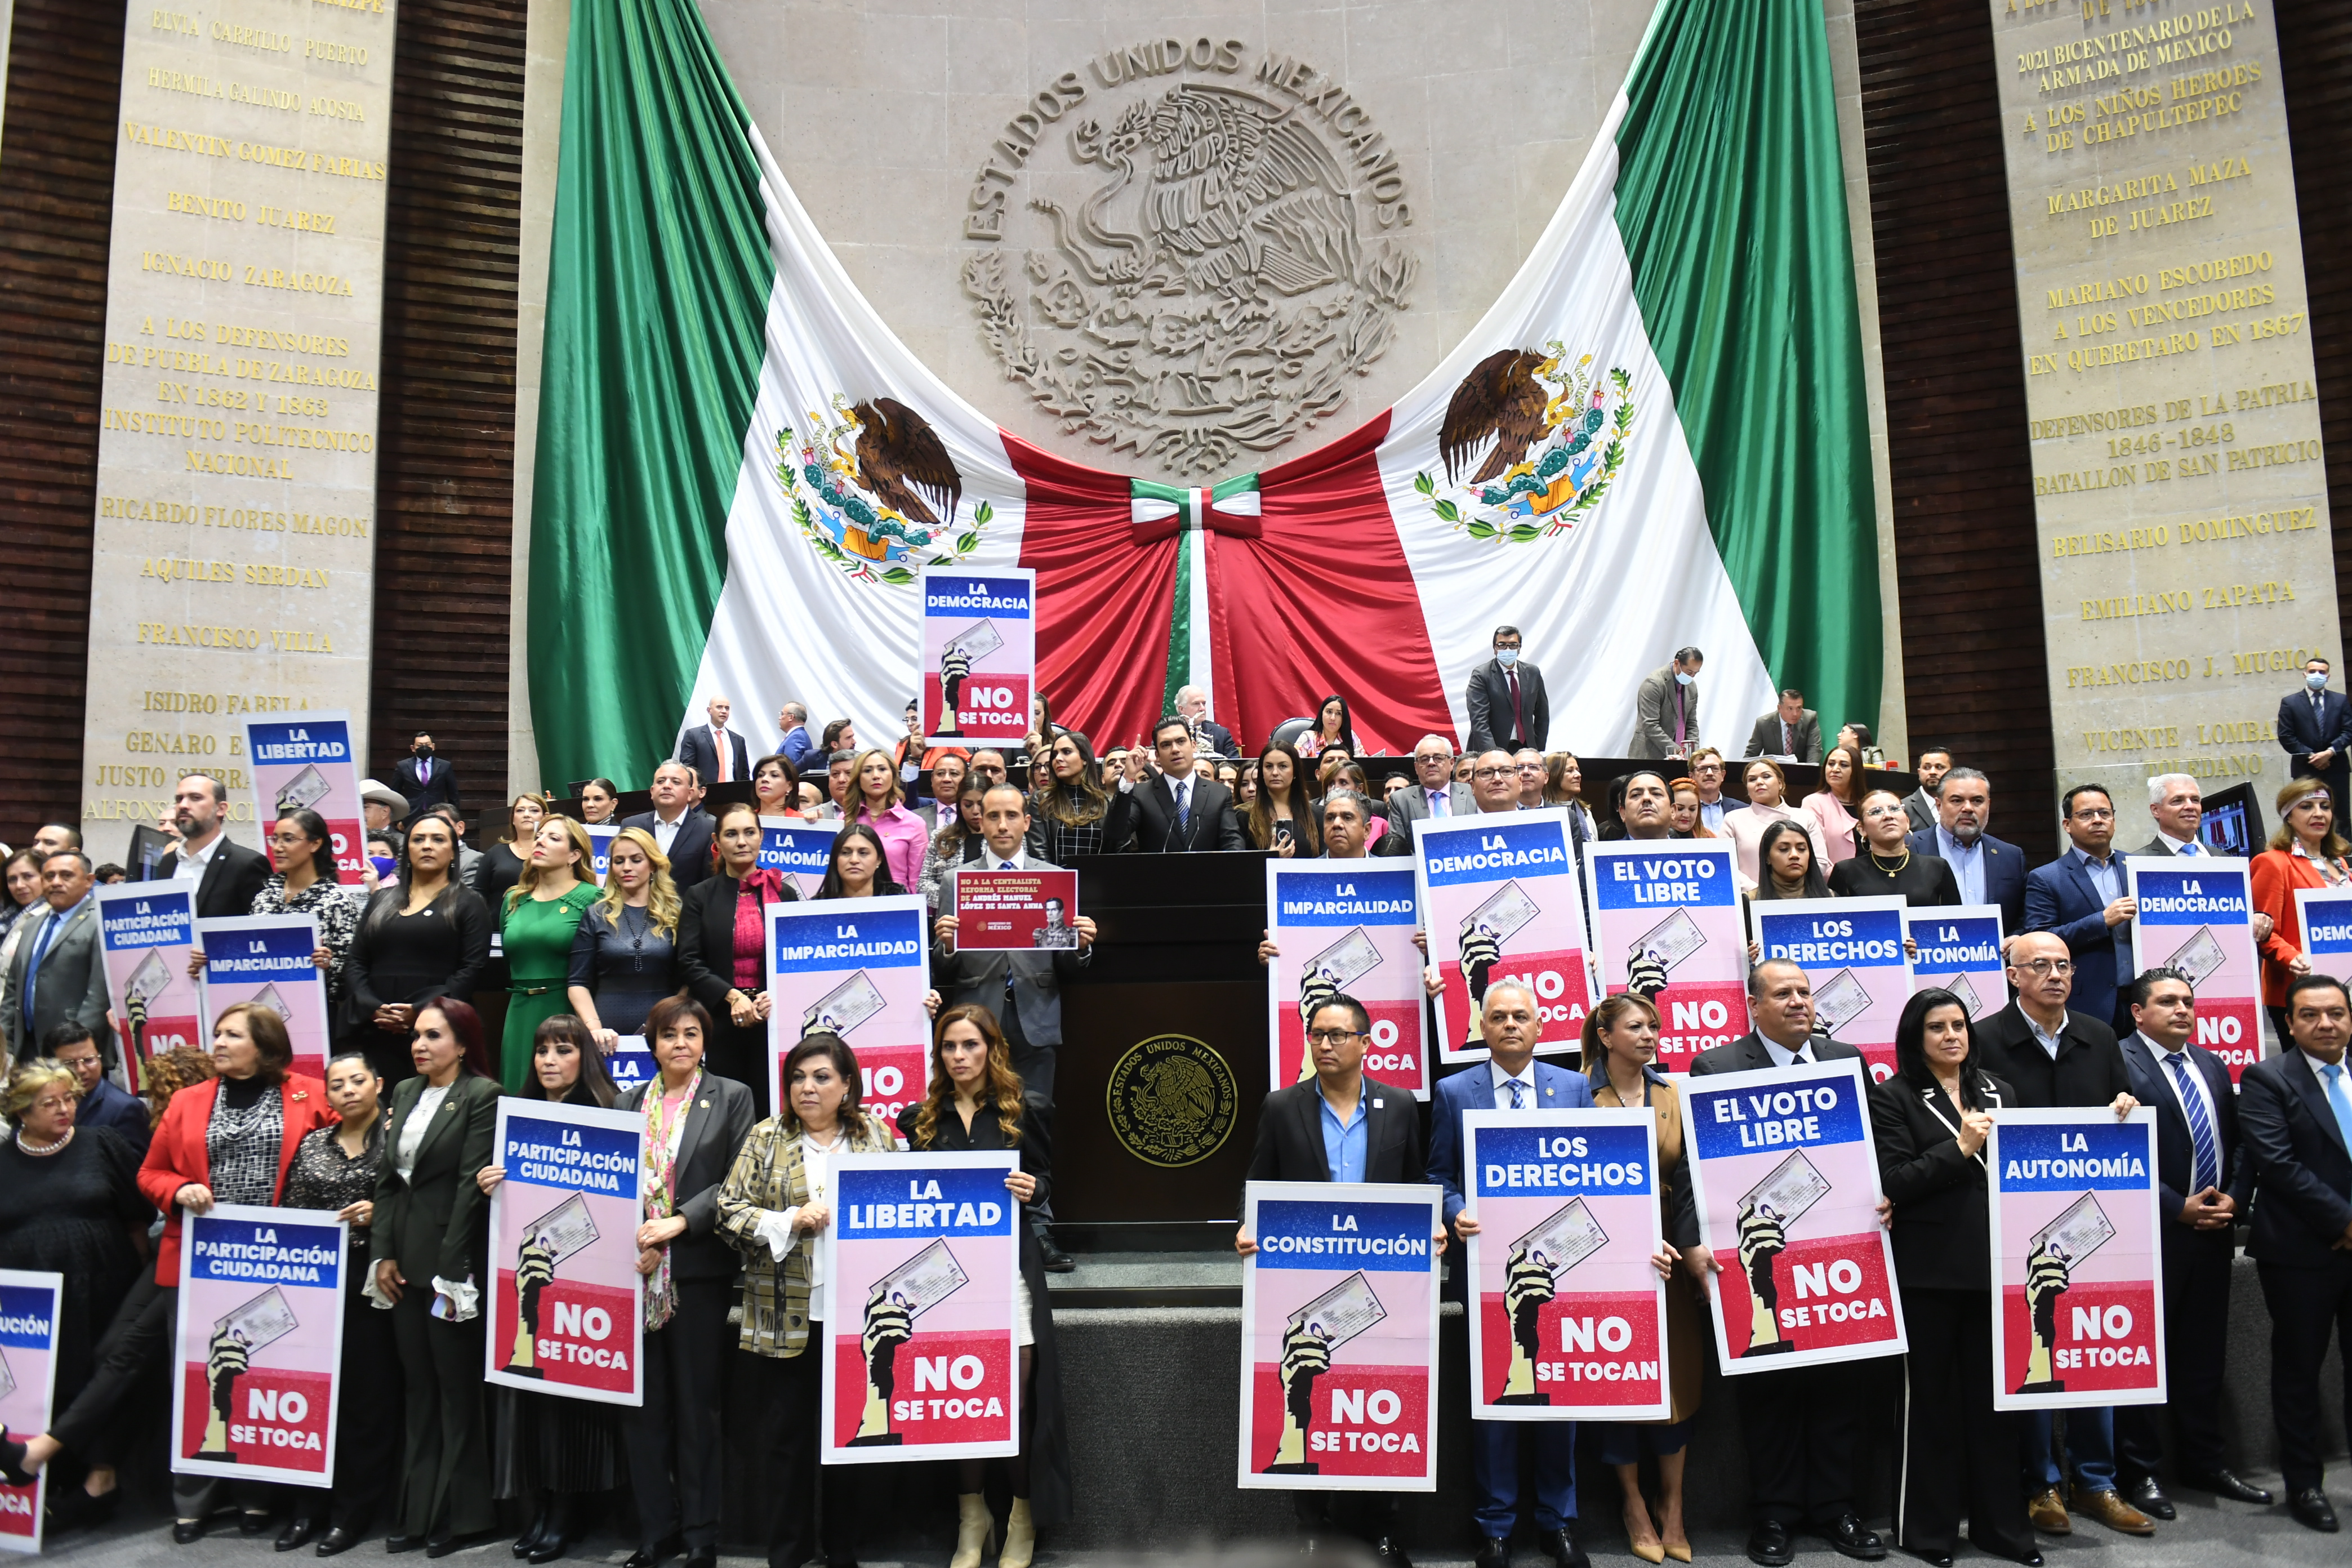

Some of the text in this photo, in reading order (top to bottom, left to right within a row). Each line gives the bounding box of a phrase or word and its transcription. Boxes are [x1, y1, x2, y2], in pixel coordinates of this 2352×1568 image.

[153, 10, 367, 65] ELVIA CARRILLO PUERTO
[2018, 0, 2255, 73] 2021 BICENTENARIO DE LA
[2039, 29, 2232, 92] ARMADA DE MEXICO
[149, 68, 364, 122] HERMILA GALINDO ACOSTA
[2023, 61, 2261, 133] A LOS NIÑOS HEROES
[2047, 91, 2242, 153] DE CHAPULTEPEC
[126, 122, 385, 180] VALENTIN GOMEZ FARIAS
[967, 38, 1413, 240] ESTADOS UNIDOS MEXICANOS
[2048, 157, 2252, 215] MARGARITA MAZA
[168, 191, 335, 234] BENITO JUAREZ
[2090, 195, 2213, 239] DE JUAREZ
[142, 251, 353, 296] IGNACIO ZARAGOZA
[2048, 251, 2273, 309] MARIANO ESCOBEDO
[2054, 284, 2275, 340] A LOS VENCEDORES
[141, 317, 348, 357] A LOS DEFENSORES
[2030, 313, 2305, 375] EN QUERETARO EN 1867
[108, 344, 375, 390] DE PUEBLA DE ZARAGOZA
[158, 381, 328, 417] EN 1862 Y 1863
[2031, 380, 2316, 441] DEFENSORES DE LA PATRIA
[104, 408, 373, 453] INSTITUTO POLITECNICO
[186, 451, 293, 479] NACIONAL
[2034, 439, 2322, 496] BATALLON DE SAN PATRICIO
[101, 497, 367, 537] RICARDO FLORES MAGON
[2053, 507, 2317, 558] BELISARIO DOMINGUEZ
[140, 558, 329, 588] AQUILES SERDAN
[969, 583, 987, 595] LA
[2081, 581, 2295, 621] EMILIANO ZAPATA
[928, 596, 1028, 609] DEMOCRACIA
[137, 623, 333, 653] FRANCISCO VILLA
[2068, 658, 2191, 688] FRANCISCO
[2203, 656, 2223, 677] J.
[144, 691, 217, 714] ISIDRO
[970, 687, 1013, 709] NO
[959, 712, 1024, 725] SE TOCA
[126, 732, 216, 754] GENARO
[289, 729, 309, 741] LA
[2084, 726, 2179, 752] VICENTE
[256, 742, 345, 759] LIBERTAD
[96, 765, 165, 787] JUSTO
[1481, 835, 1508, 852] LA
[1428, 847, 1565, 874] DEMOCRACIA
[1613, 859, 1715, 881] EL VOTO
[1336, 884, 1356, 897] LA
[1634, 882, 1700, 903] LIBRE
[2182, 880, 2202, 895] LA
[136, 902, 151, 914] LA
[1284, 899, 1413, 915] IMPARCIALIDAD
[2141, 897, 2246, 912] DEMOCRACIA
[105, 910, 189, 932] PARTICIPACIÓN
[837, 924, 858, 939] LA
[1812, 920, 1853, 938] LOS
[1939, 926, 1960, 942] LA
[114, 929, 181, 946] CIUDADANA
[250, 941, 268, 954] LA
[782, 941, 919, 960] IMPARCIALIDAD
[1771, 939, 1898, 962] DERECHOS
[210, 956, 313, 972] IMPARCIALIDAD
[1113, 1041, 1232, 1099] ESTADOS UNIDOS MEXICANOS
[1713, 1086, 1837, 1123] EL VOTO
[562, 1129, 582, 1147] LA
[1739, 1116, 1821, 1148] LIBRE
[2061, 1133, 2088, 1152] LA
[508, 1141, 635, 1174] PARTICIPACIÓN
[1539, 1137, 1588, 1158] LOS
[520, 1162, 619, 1191] CIUDADANA
[1486, 1162, 1643, 1187] DERECHOS
[2005, 1152, 2145, 1179] AUTONOMÍA
[910, 1180, 942, 1200] LA
[849, 1202, 1001, 1229] LIBERTAD
[1333, 1214, 1358, 1231] LA
[255, 1228, 278, 1244] LA
[1263, 1233, 1426, 1256] CONSTITUCIÓN
[195, 1241, 337, 1265] PARTICIPACIÓN
[210, 1260, 320, 1282] CIUDADANA
[1561, 1316, 1632, 1353] NO
[1536, 1361, 1658, 1382] SE TOCAN
[1331, 1388, 1402, 1424] NO
[1311, 1432, 1420, 1453] SE TOCA
